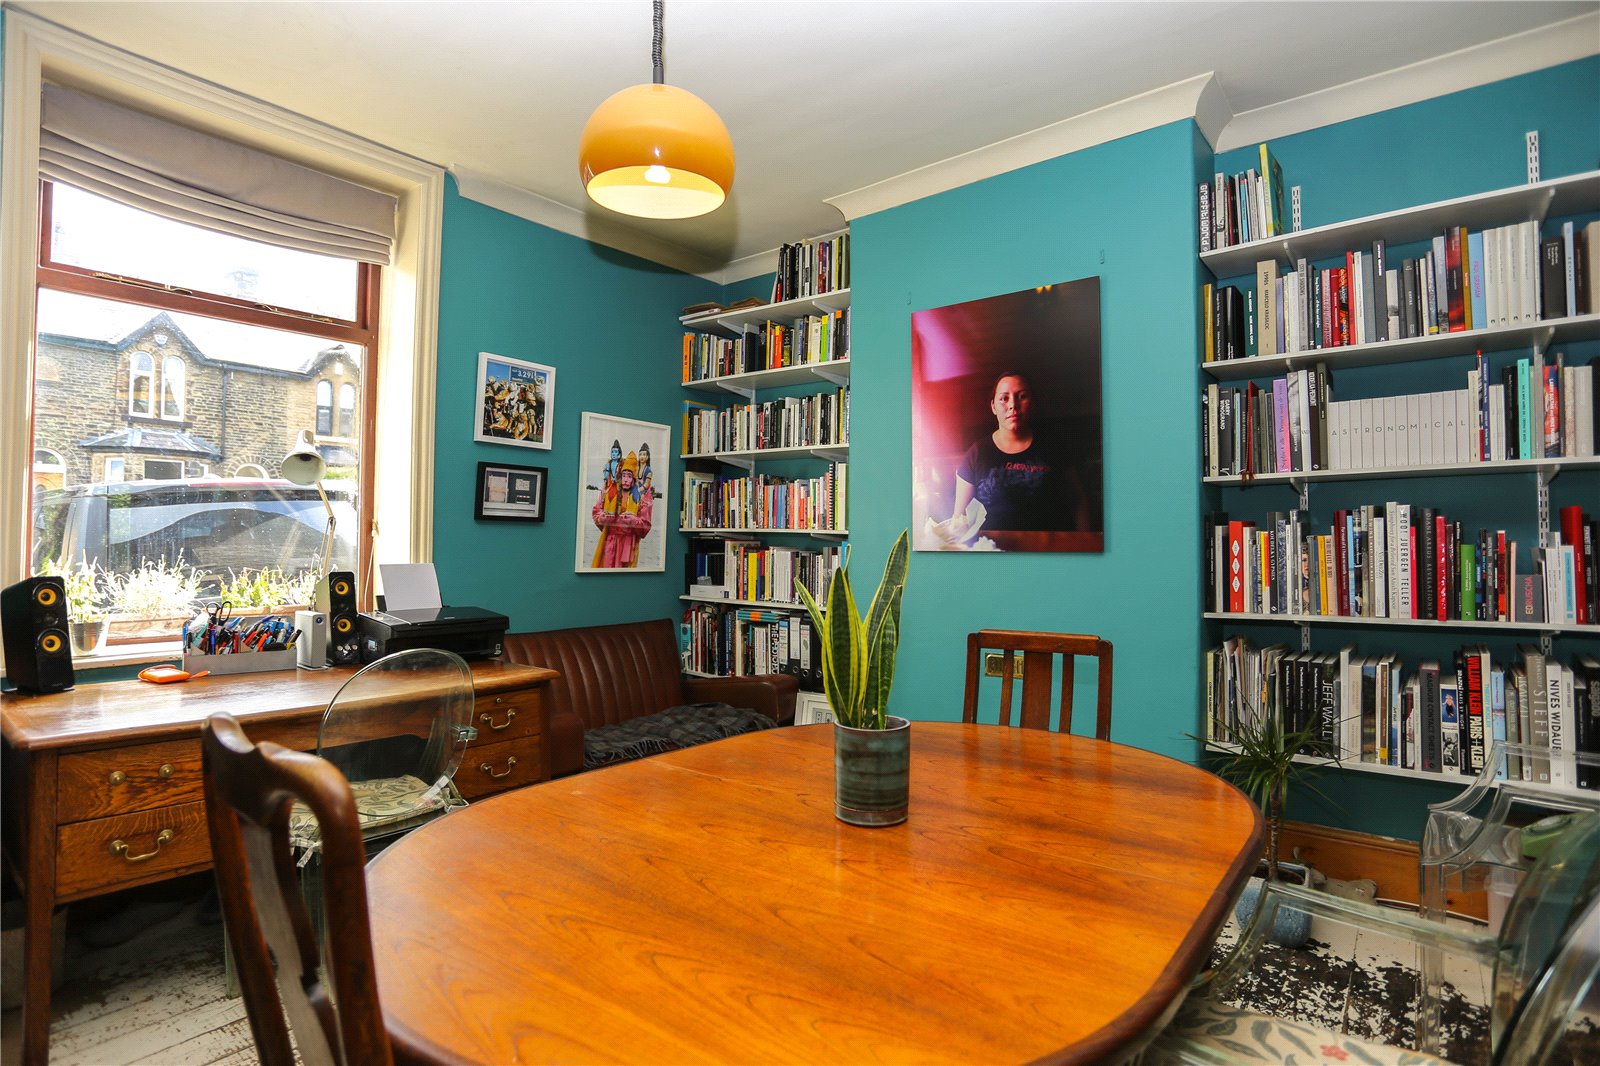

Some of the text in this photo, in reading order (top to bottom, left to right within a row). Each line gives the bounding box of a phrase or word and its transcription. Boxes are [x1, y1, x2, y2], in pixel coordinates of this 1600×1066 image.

[1331, 419, 1466, 436] ASTRONOMICAL
[1400, 538, 1408, 572] JUERGEN
[1401, 578, 1409, 605] TELLER
[1322, 680, 1332, 704] JEFF
[1467, 657, 1482, 715] WILLIAM KLEIN
[1534, 690, 1548, 737] SIEFF
[1550, 679, 1561, 757] NIVES WIDAUE
